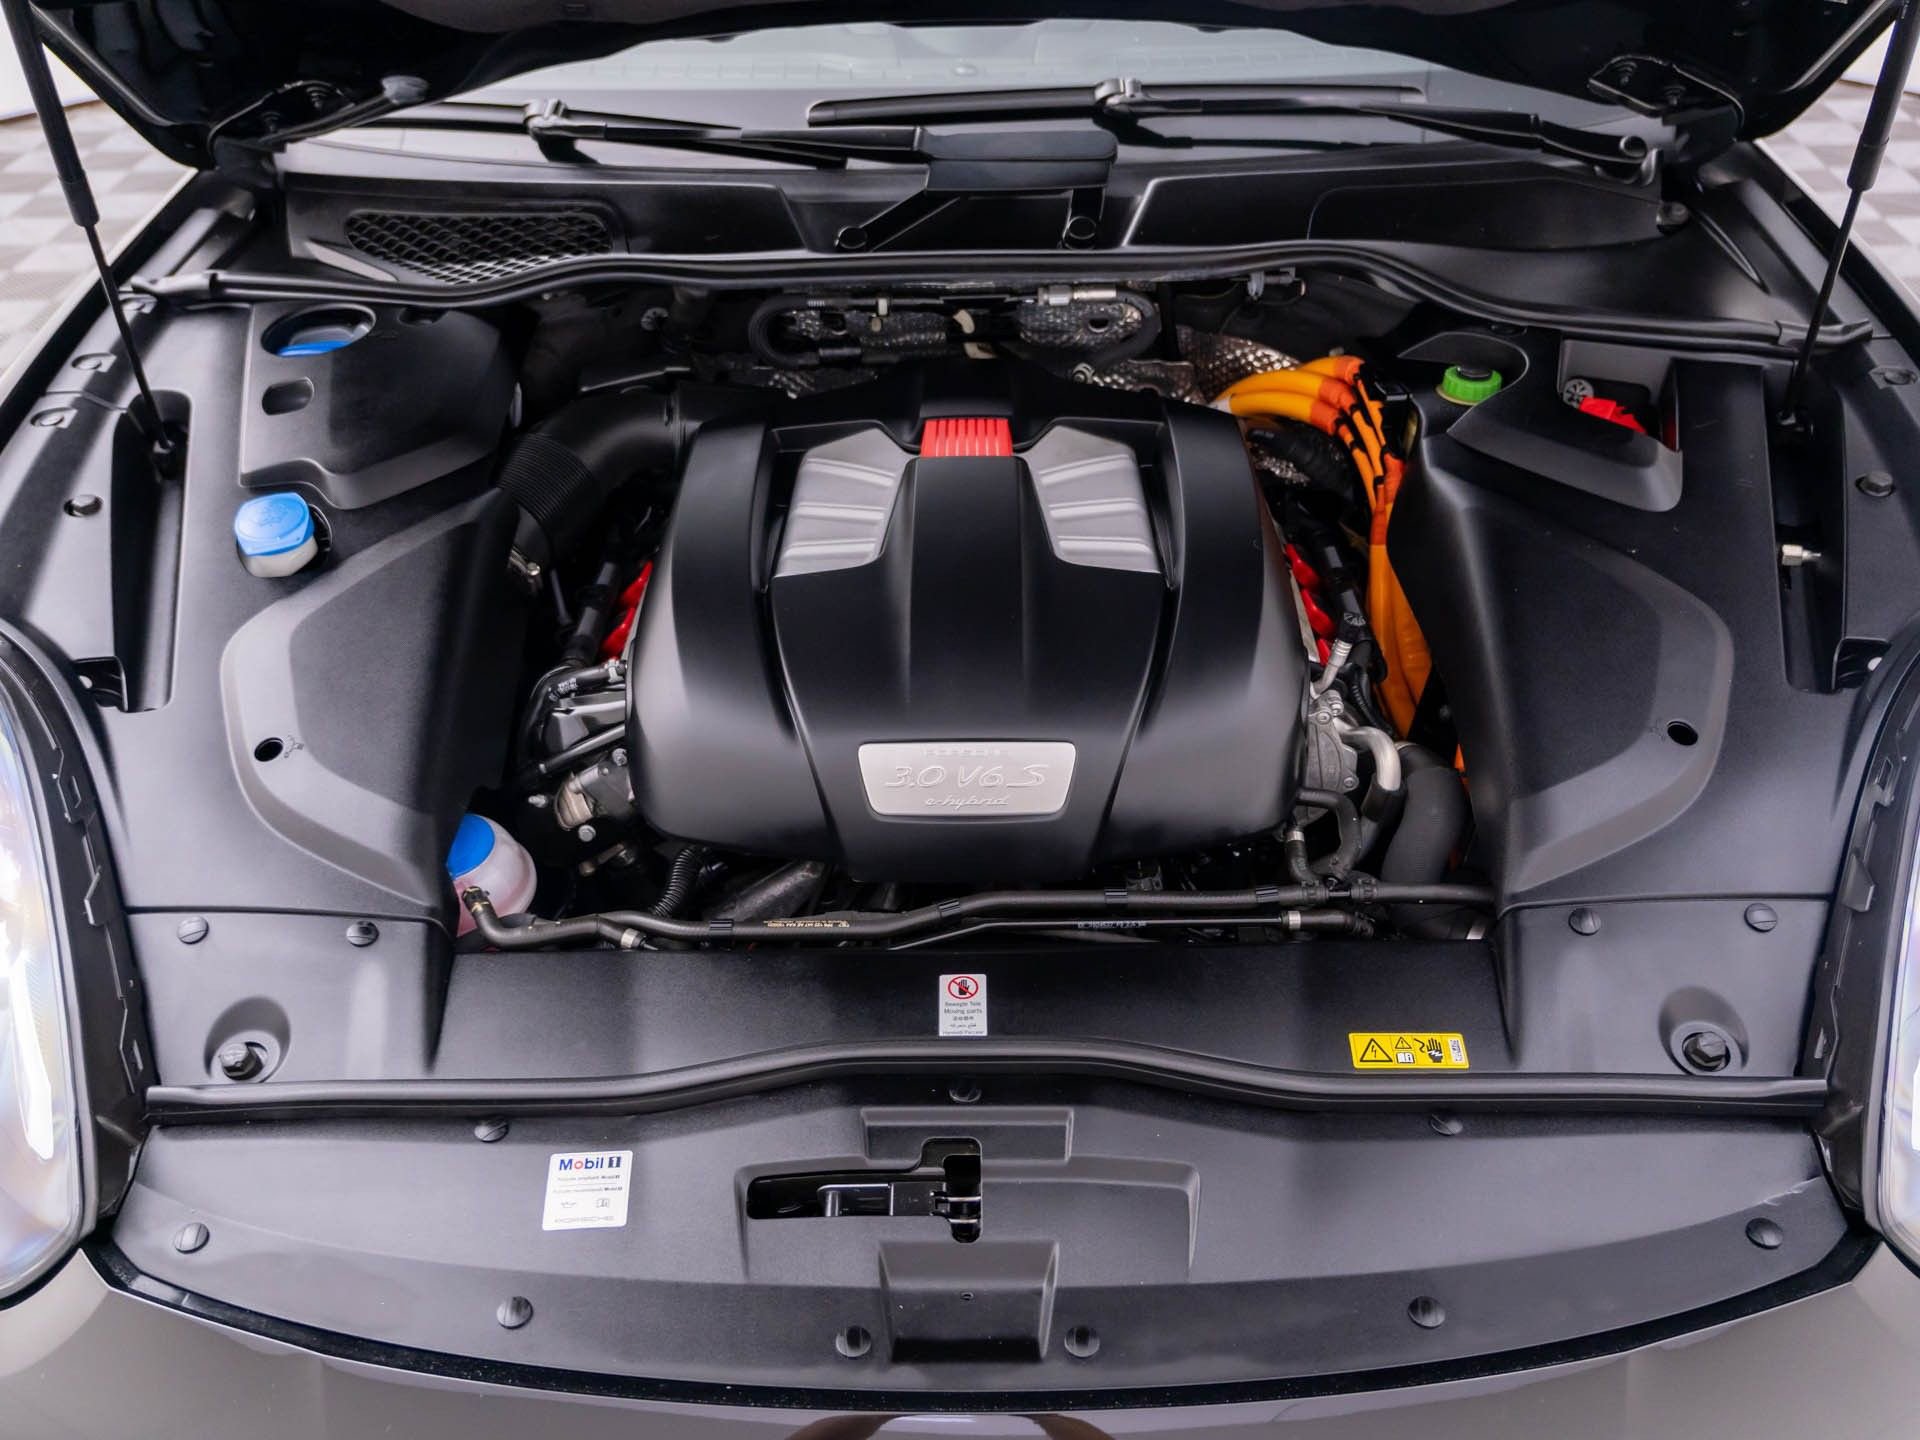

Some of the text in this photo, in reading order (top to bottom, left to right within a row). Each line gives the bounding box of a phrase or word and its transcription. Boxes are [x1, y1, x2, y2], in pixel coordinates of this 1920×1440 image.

[885, 764, 1049, 788] 3.0 V6 S
[925, 794, 1010, 811] e-hybrid
[559, 1156, 621, 1171] Mobil 1
